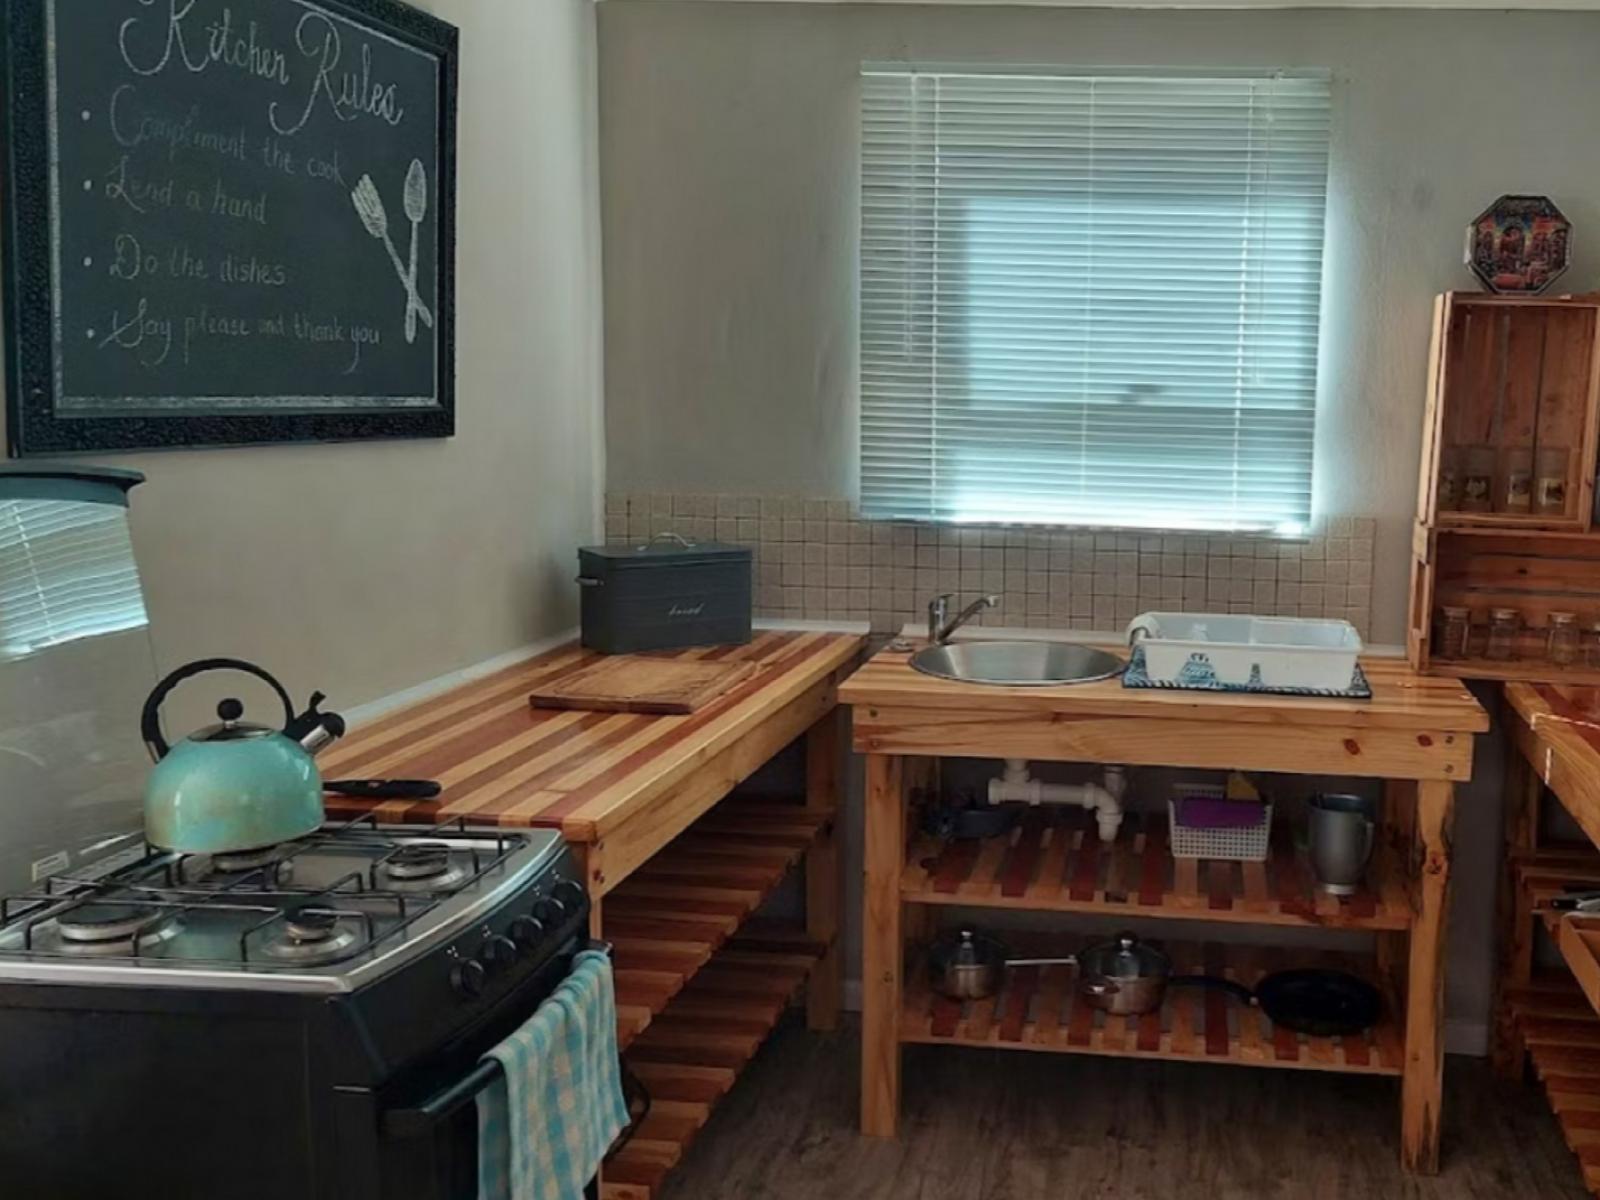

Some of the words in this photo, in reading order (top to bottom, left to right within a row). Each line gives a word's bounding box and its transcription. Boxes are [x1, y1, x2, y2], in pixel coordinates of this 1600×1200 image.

[119, 0, 289, 85] Kitchen
[269, 11, 403, 135] Rules
[104, 155, 174, 214] Lend
[186, 190, 202, 211] a
[211, 178, 268, 225] hand
[260, 136, 296, 176] the
[306, 151, 347, 188] cook
[109, 233, 158, 280] Do
[168, 245, 209, 279] the
[219, 253, 286, 287] dishes
[97, 297, 171, 367] Say
[184, 305, 251, 365] please
[294, 311, 343, 342] thank
[342, 325, 380, 375] you
